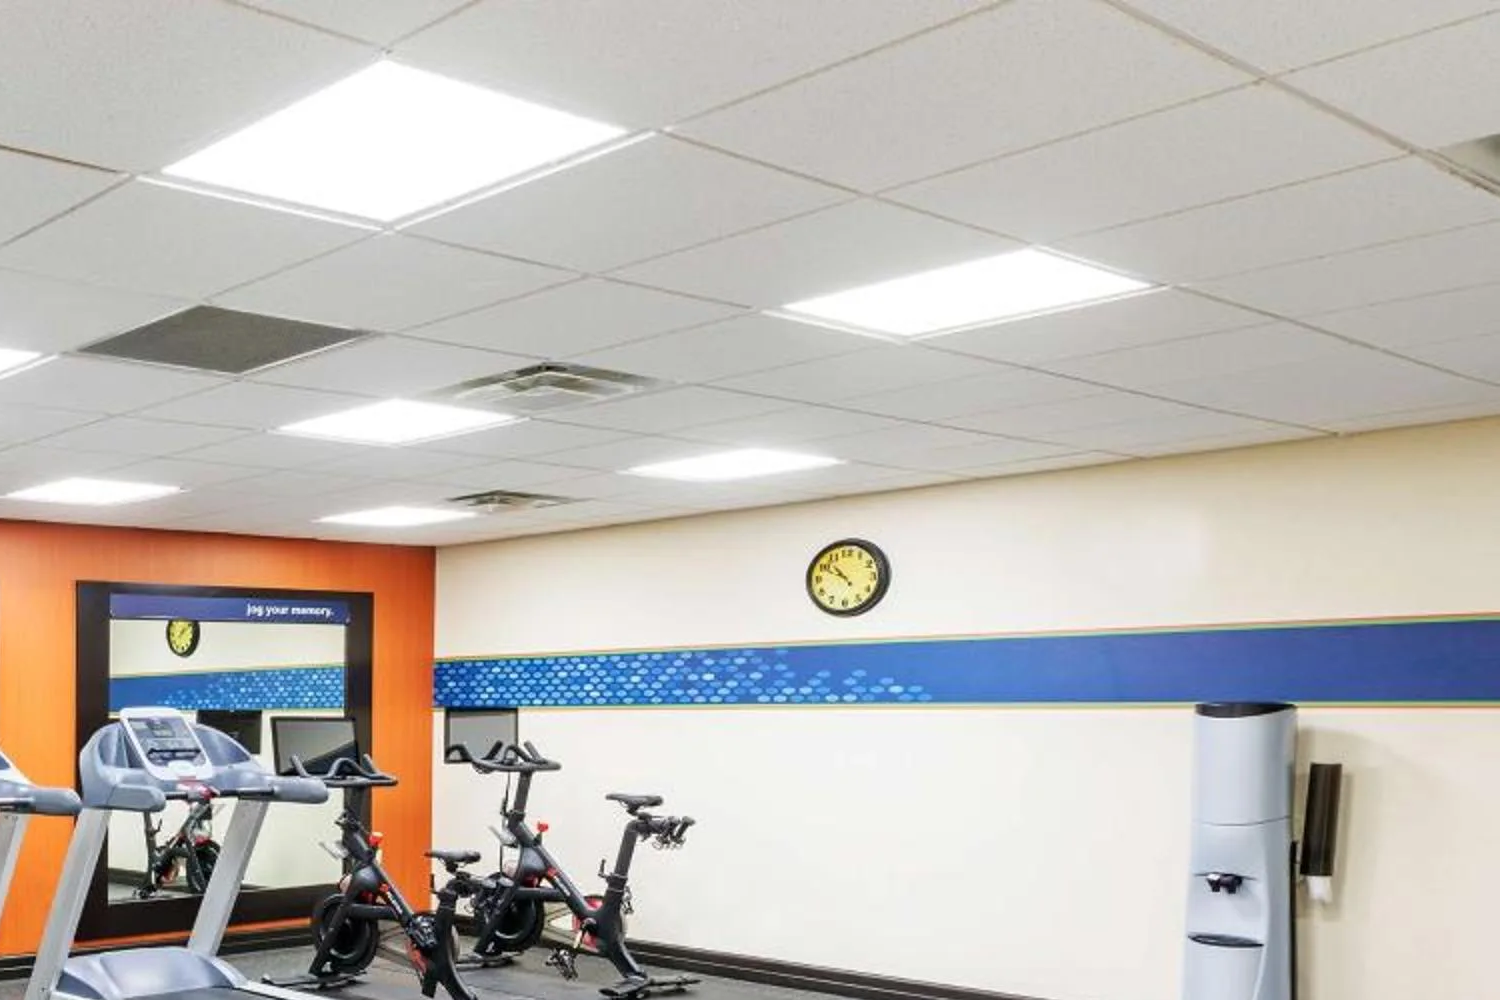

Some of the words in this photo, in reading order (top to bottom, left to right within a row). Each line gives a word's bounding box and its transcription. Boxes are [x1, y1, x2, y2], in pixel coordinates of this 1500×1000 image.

[247, 603, 264, 617] jog
[265, 606, 289, 617] your
[291, 607, 335, 618] memory.
